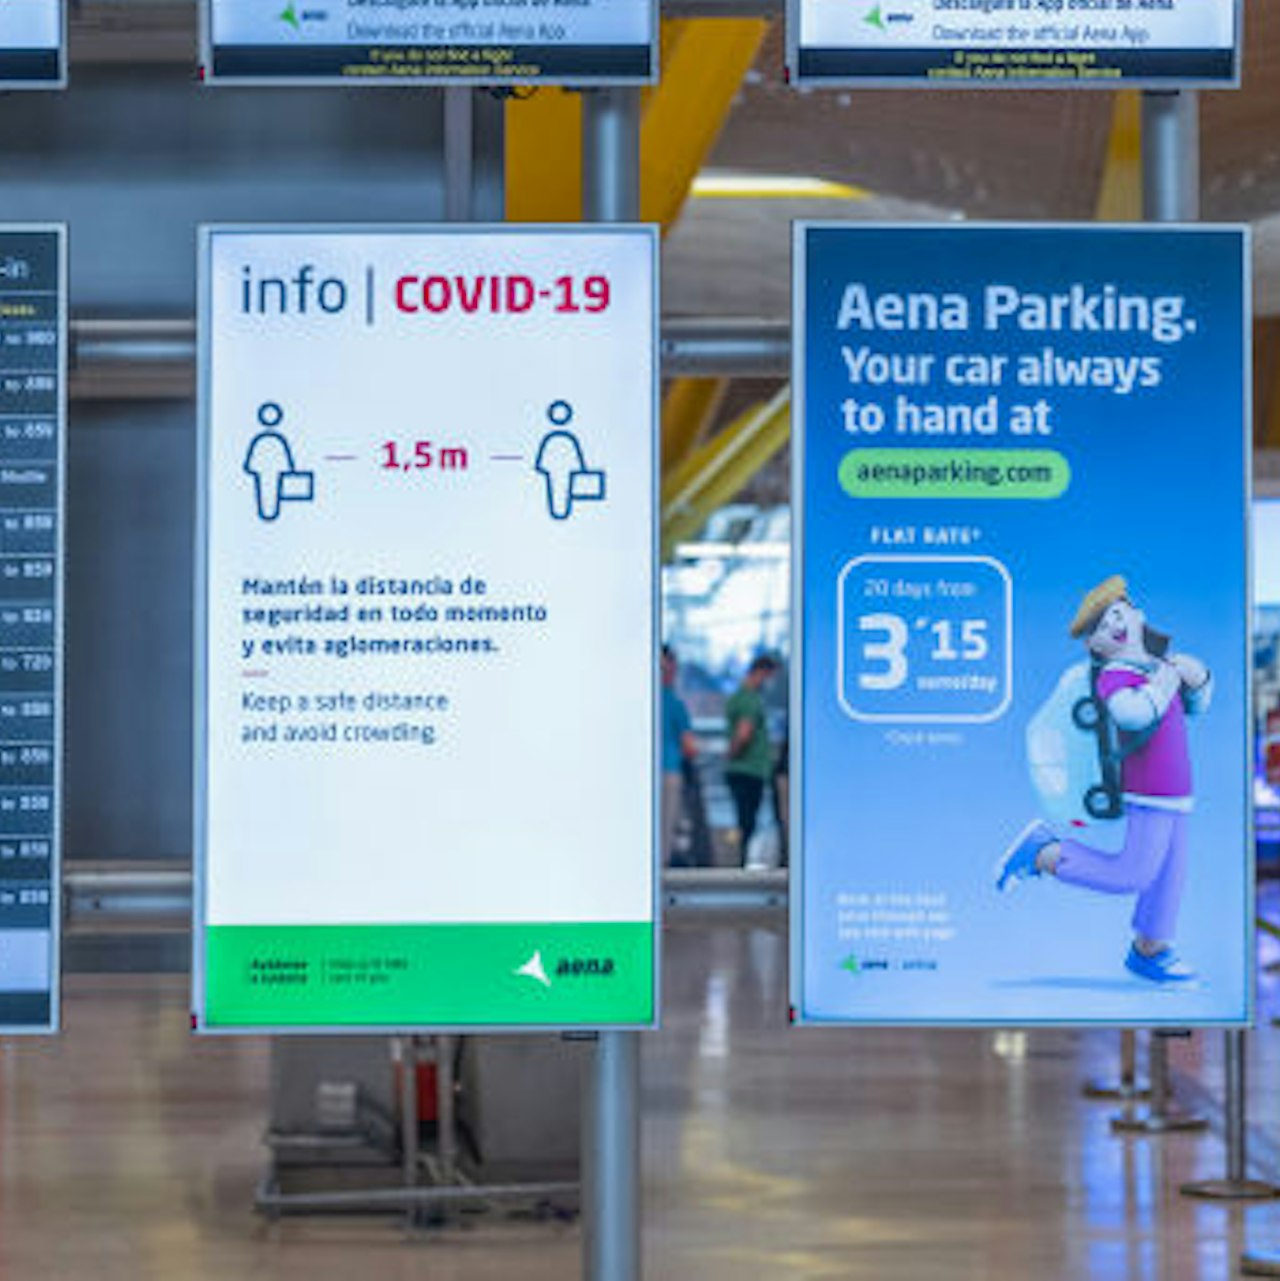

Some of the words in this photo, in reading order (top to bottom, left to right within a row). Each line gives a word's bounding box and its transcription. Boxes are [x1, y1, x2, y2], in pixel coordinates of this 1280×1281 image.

[241, 265, 347, 315] info
[394, 275, 610, 314] COVID-19
[837, 284, 969, 331] Aena
[984, 285, 1197, 342] Parking.
[841, 347, 934, 385] Your
[945, 355, 1008, 385] car
[1018, 348, 1161, 394] always
[842, 399, 883, 433] to
[896, 397, 997, 434] hand
[1009, 399, 1051, 434] at
[856, 460, 1051, 487] aenaparking.com
[871, 528, 917, 544] FLAT
[243, 577, 323, 595] Mantén
[331, 577, 347, 595] la
[355, 577, 452, 595] distancia
[460, 577, 485, 595] de
[865, 580, 887, 596] 20
[893, 580, 930, 599] days
[938, 580, 977, 596] from
[243, 604, 348, 626] seguridad
[357, 607, 382, 621] en
[391, 604, 438, 621] todo
[445, 605, 547, 622] momento
[243, 640, 254, 659] y
[261, 635, 316, 654] evita
[324, 635, 500, 658] aglomeraciones.
[243, 691, 291, 715] Keep
[299, 696, 309, 710] a
[318, 691, 355, 710] safe
[363, 691, 448, 710] distance
[243, 724, 277, 742] and
[284, 724, 337, 742] avoid
[556, 957, 614, 976] aena
